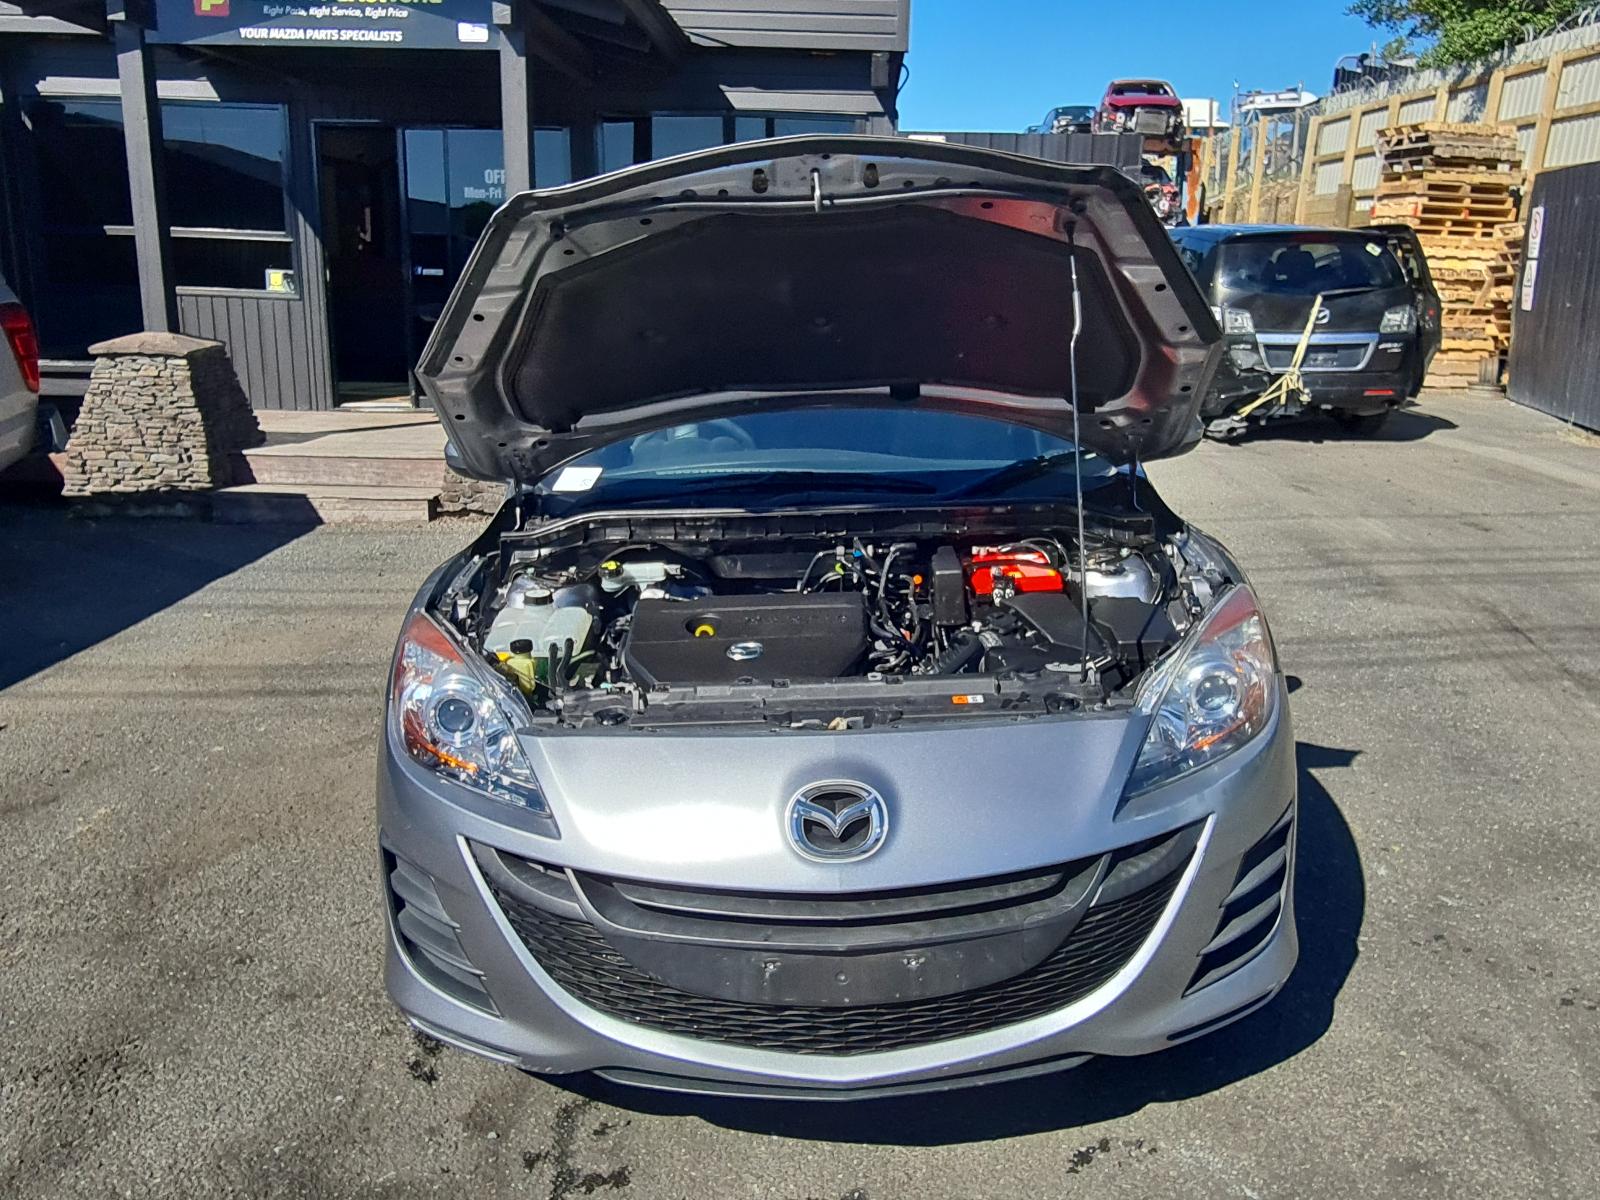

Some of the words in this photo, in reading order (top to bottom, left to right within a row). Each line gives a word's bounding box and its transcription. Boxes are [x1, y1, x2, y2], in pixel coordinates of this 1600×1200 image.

[263, 5, 284, 16] Right
[309, 6, 330, 18] Right
[331, 6, 363, 17] Service,
[365, 7, 387, 19] Right
[388, 7, 408, 18] Price
[240, 27, 268, 39] YOUR
[269, 28, 305, 40] MAZDA
[306, 29, 339, 40] PARTS
[339, 29, 403, 41] SPECIALISTS
